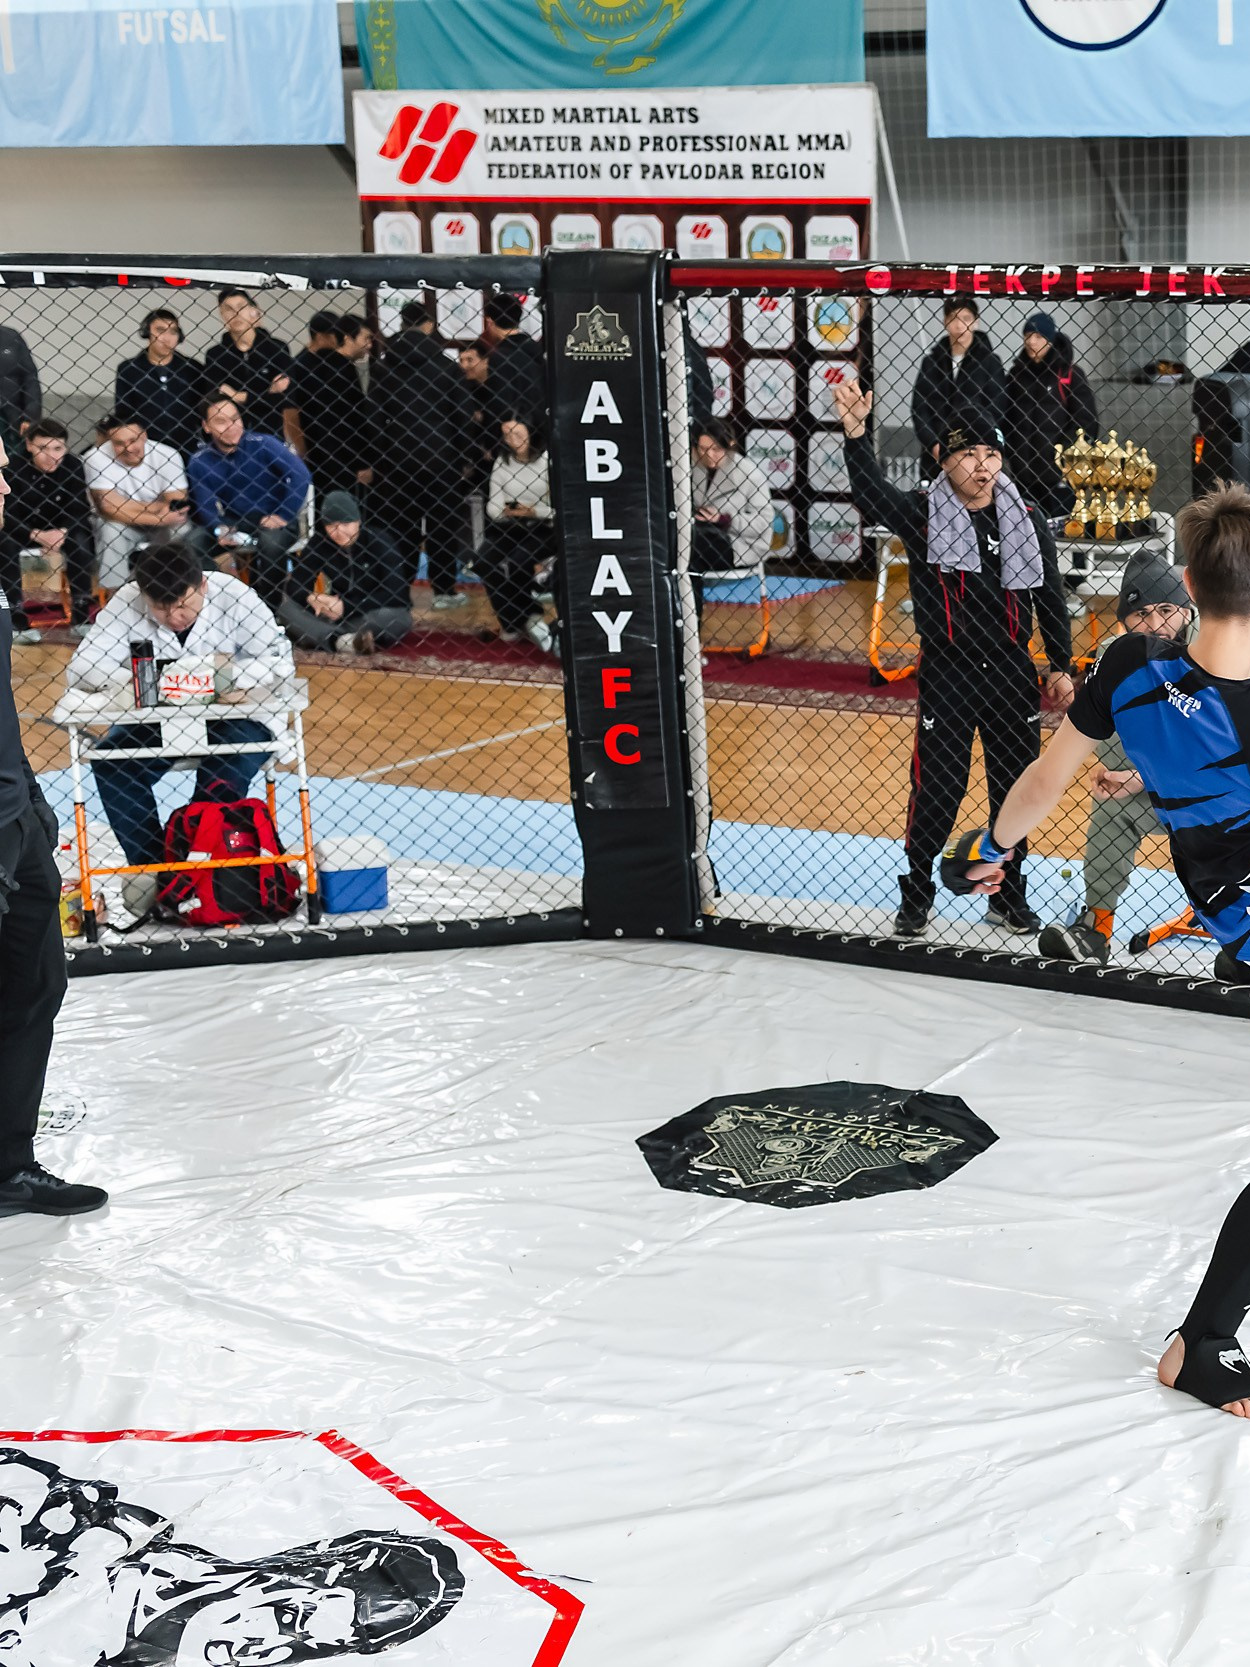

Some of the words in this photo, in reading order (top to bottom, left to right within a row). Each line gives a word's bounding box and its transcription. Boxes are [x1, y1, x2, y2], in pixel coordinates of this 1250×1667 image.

[116, 9, 226, 45] FUTSAL
[483, 107, 545, 124] MIXED
[553, 107, 641, 124] MARTIAL
[649, 106, 699, 124] ARTS
[484, 132, 582, 153] (AMATEUR
[590, 135, 631, 152] AND
[639, 134, 789, 152] PROFESSIONAL
[797, 130, 852, 153] MMA)
[487, 163, 601, 180] FEDERATION
[610, 163, 633, 180] OF
[641, 163, 744, 180] PAVLODAR
[752, 162, 826, 180] REGION
[942, 264, 1095, 296] JEKPE
[1135, 265, 1227, 297] JEK
[580, 381, 633, 653] ABLAY
[1164, 681, 1202, 710] GREEN
[601, 667, 642, 766] FC
